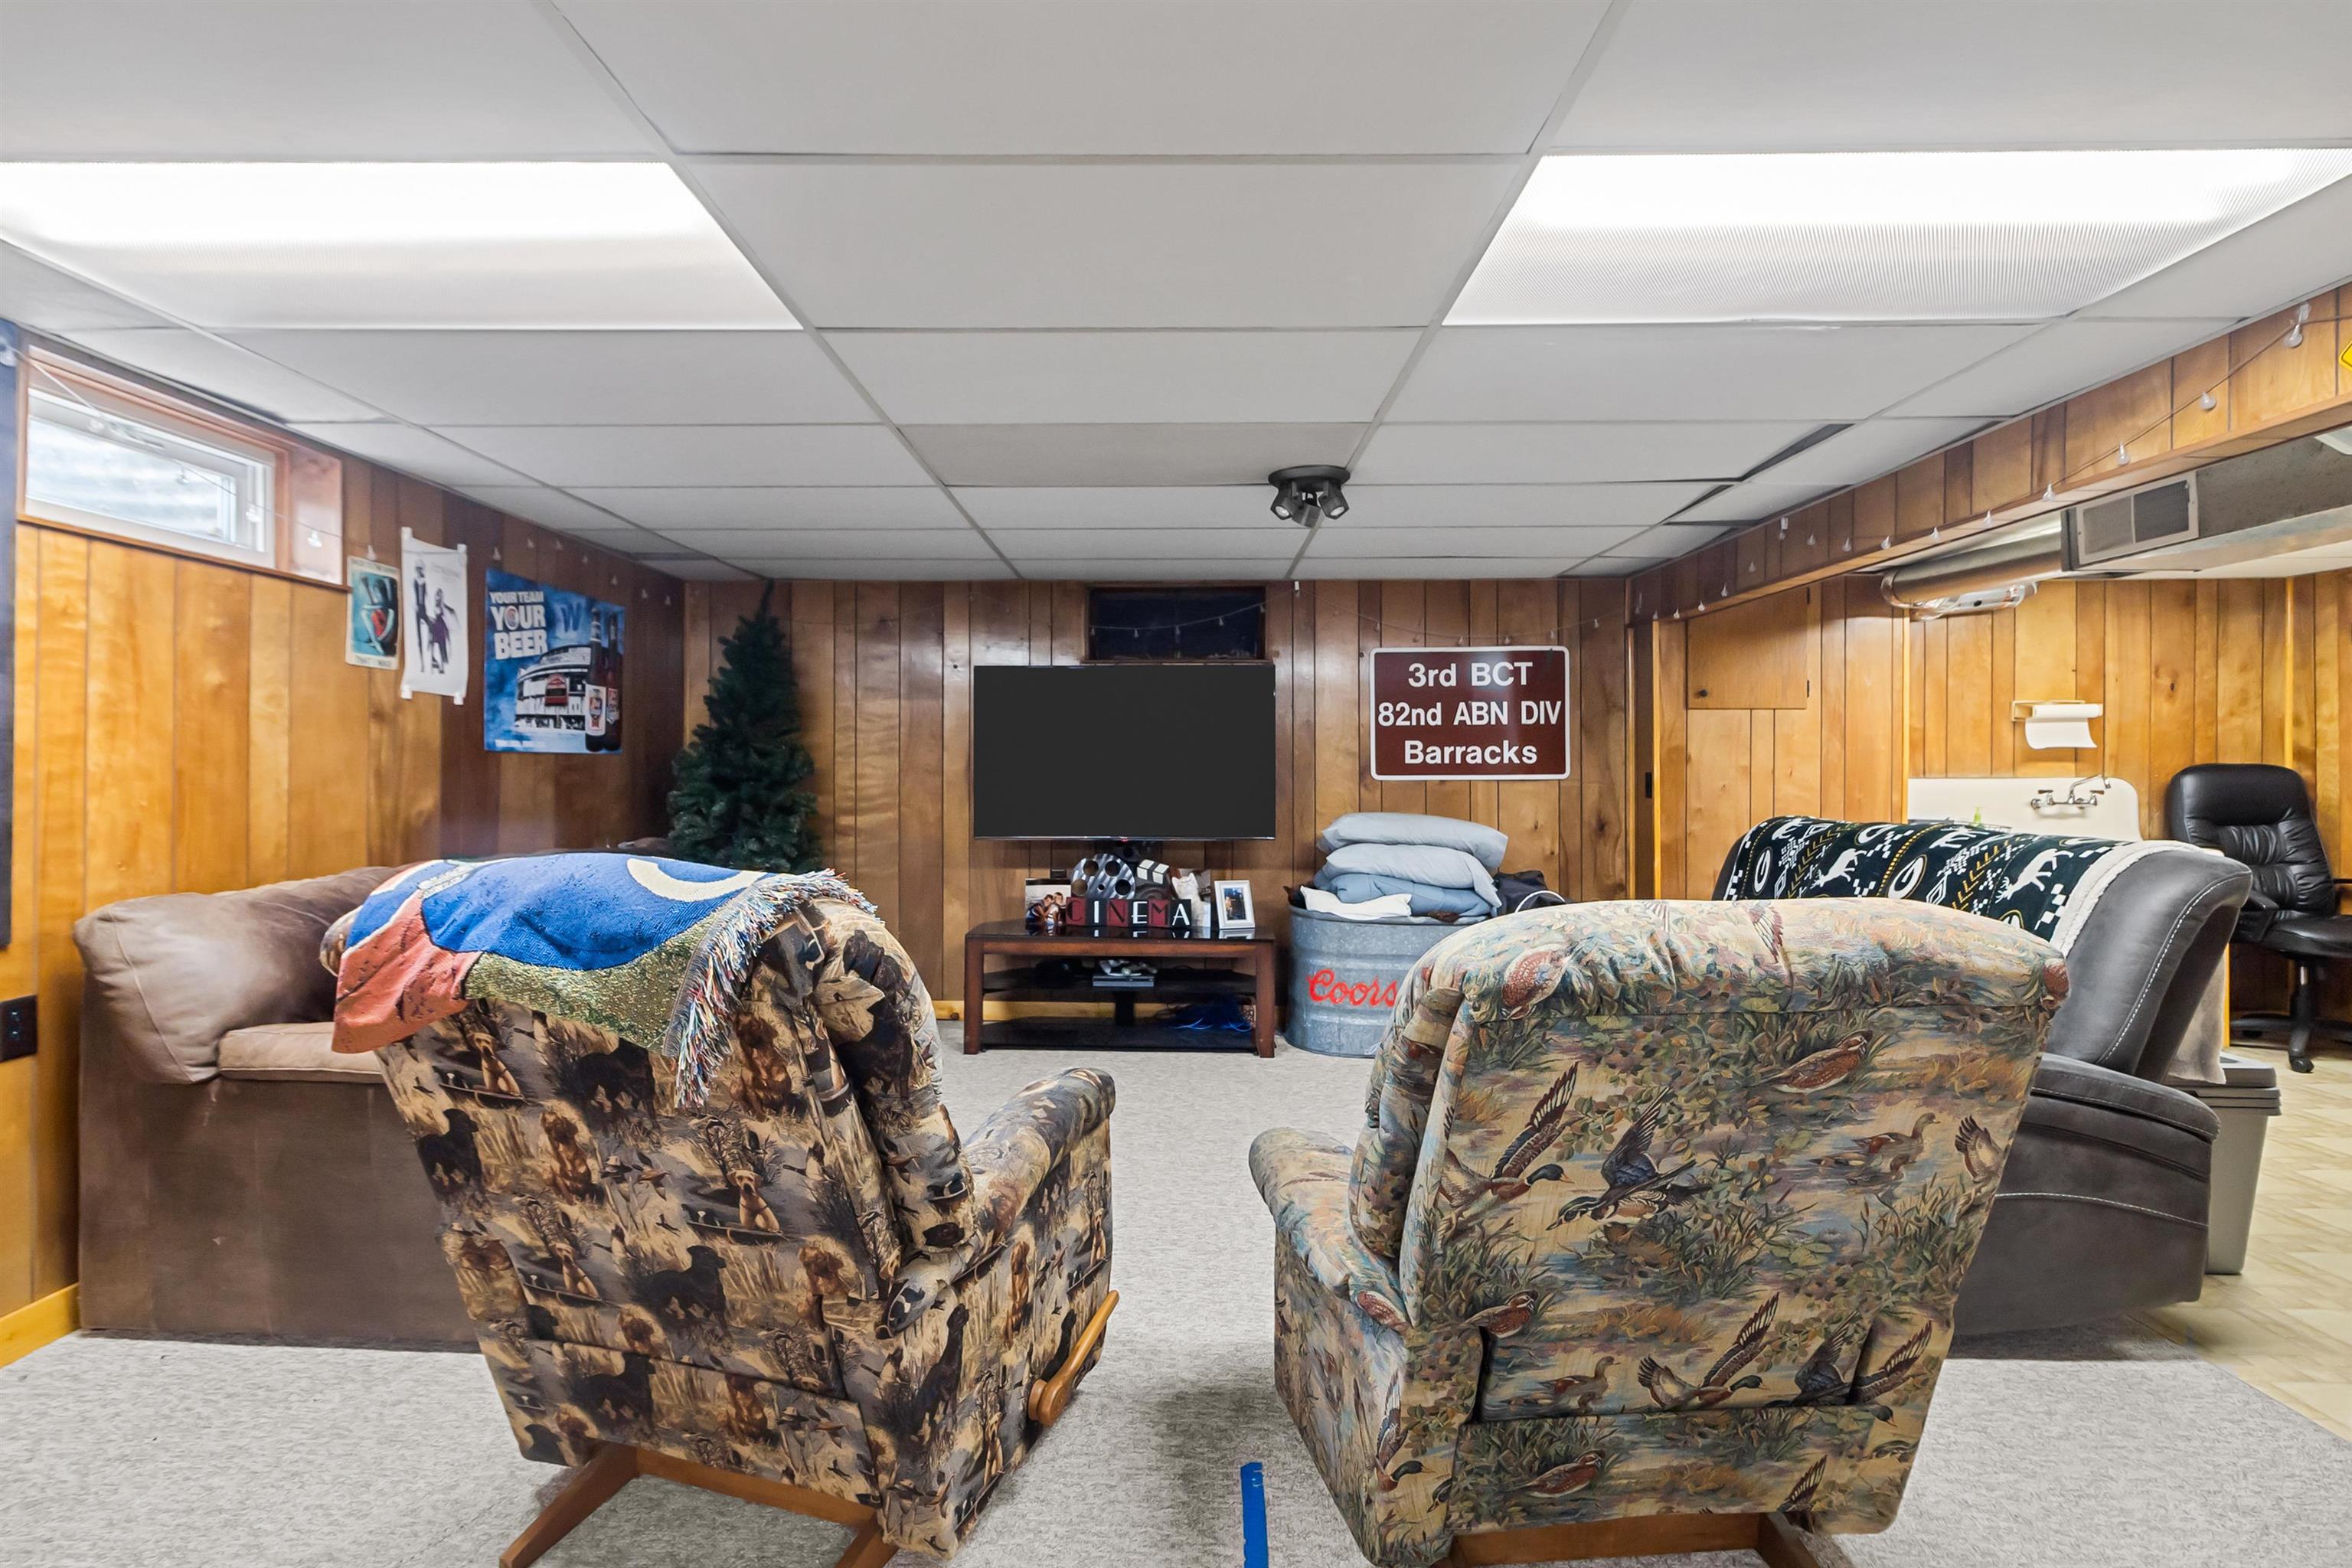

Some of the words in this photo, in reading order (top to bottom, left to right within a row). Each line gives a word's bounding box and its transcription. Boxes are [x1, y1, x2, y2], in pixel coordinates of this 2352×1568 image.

[489, 592, 517, 604] YOUR
[518, 591, 544, 603] TEAM
[490, 605, 546, 630] YOUR
[494, 629, 549, 659] BEER
[1408, 663, 1457, 687] 3rd
[1471, 662, 1533, 686] BCT
[1378, 702, 1442, 727] 82nd
[1453, 701, 1508, 725] ABN
[1521, 701, 1561, 724] DIV
[1404, 740, 1537, 764] Barracks
[1067, 900, 1191, 926] CINEMA
[1307, 969, 1397, 1008] Coors
